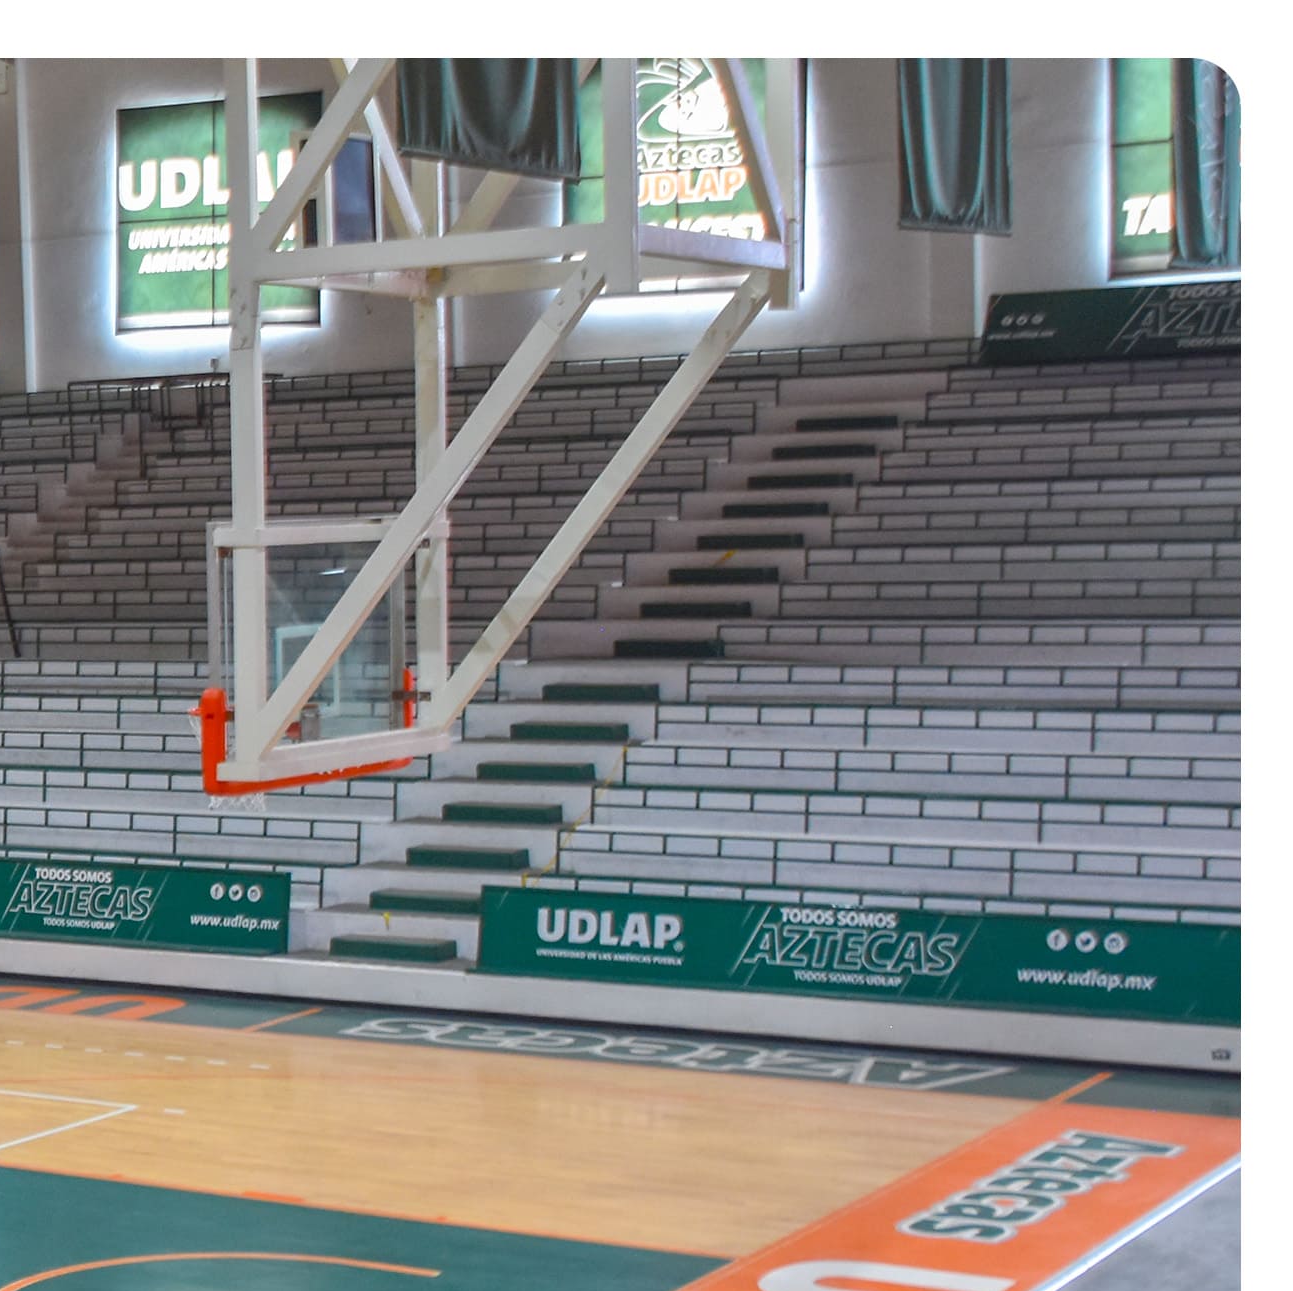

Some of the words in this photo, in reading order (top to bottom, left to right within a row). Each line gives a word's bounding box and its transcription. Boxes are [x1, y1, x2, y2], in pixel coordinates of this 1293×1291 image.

[35, 868, 72, 881] TODOS
[72, 870, 113, 884] SOMOS
[10, 881, 153, 921] AZTECAS
[43, 918, 66, 926] TODOS
[66, 919, 91, 929] SOMOS
[91, 921, 115, 930] UDLAP
[190, 913, 280, 931] www.udlap.mx
[537, 907, 683, 949] UDLAP
[780, 907, 835, 926] TODOS
[836, 910, 898, 930] SOMOS
[536, 949, 587, 959] UNIVERSIDAD
[743, 923, 961, 977] AZTECAS
[794, 969, 828, 983] TODOS
[828, 972, 865, 985] SOMOS
[866, 975, 902, 988] UDLAP
[1017, 968, 1156, 991] www.udlap.mx
[895, 1129, 1186, 1245] Aztecas
